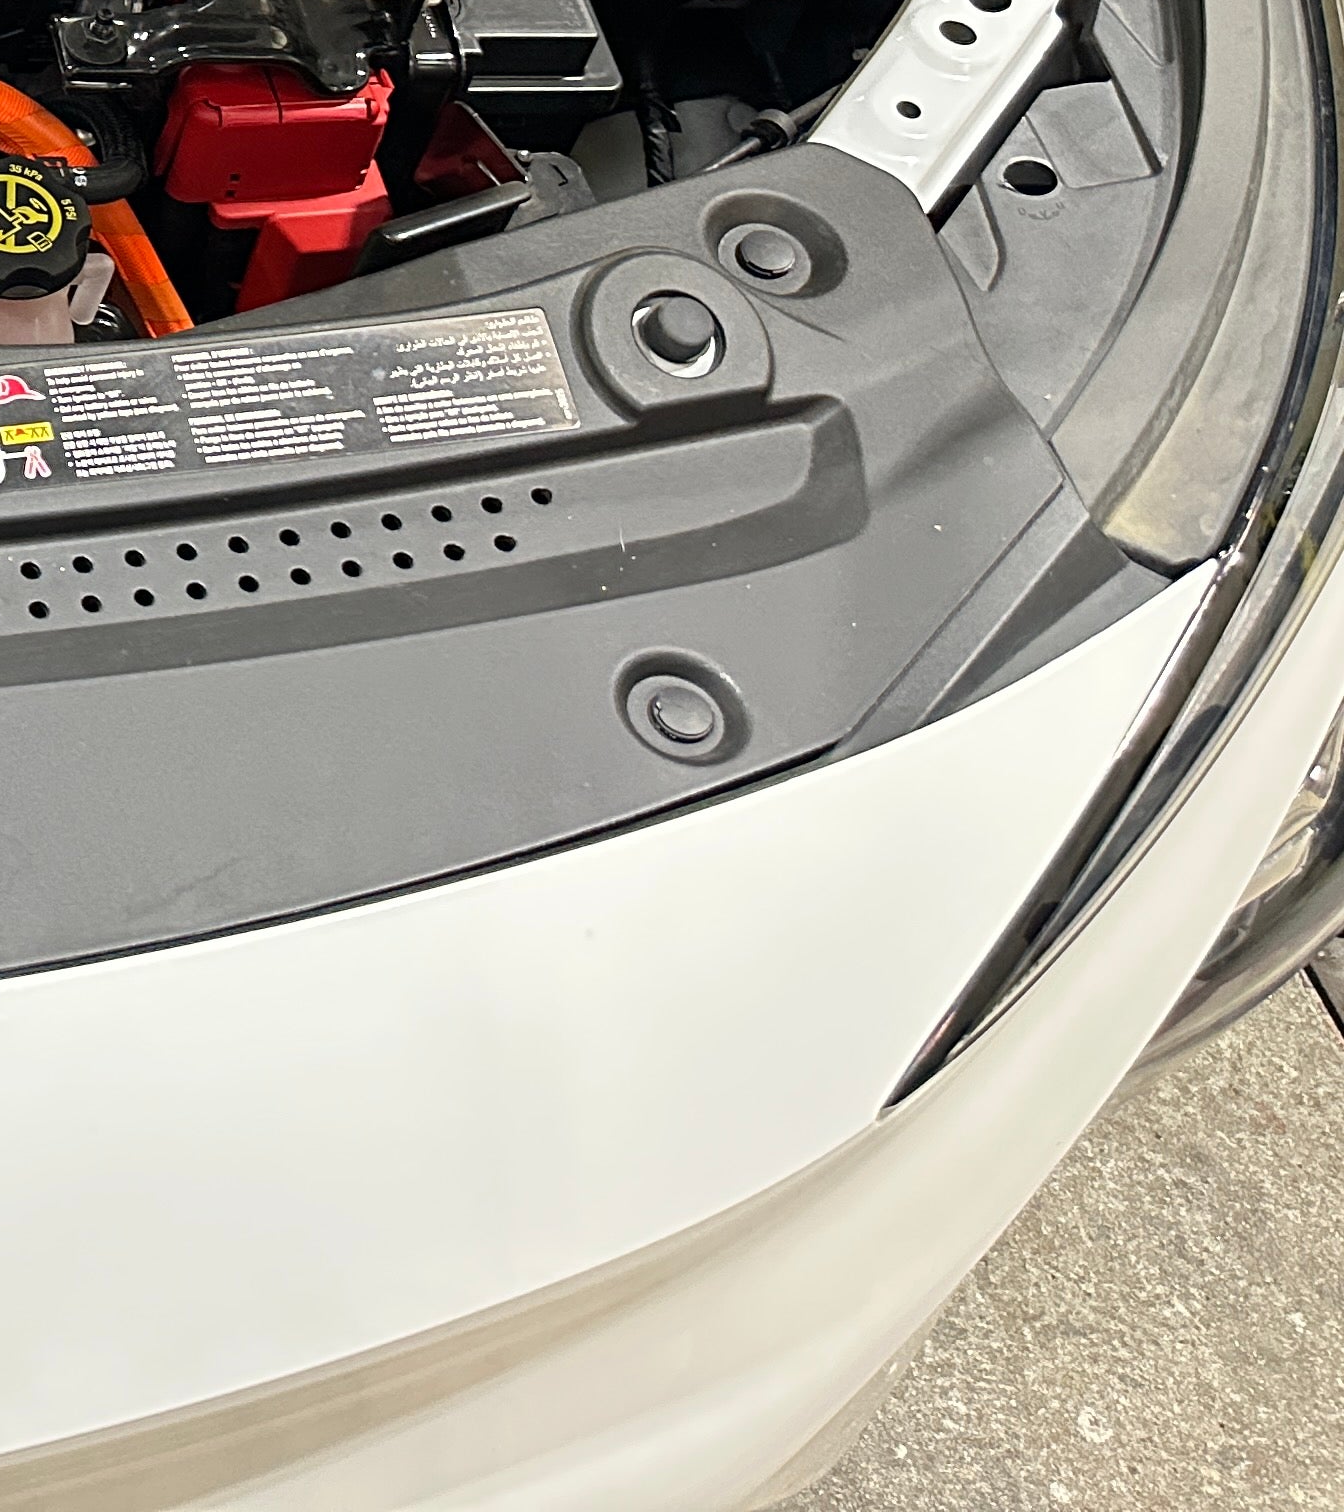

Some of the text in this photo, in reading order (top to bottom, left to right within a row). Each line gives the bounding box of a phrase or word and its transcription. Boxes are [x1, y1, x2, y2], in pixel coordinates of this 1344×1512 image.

[9, 163, 44, 181] 35 kPa
[63, 205, 78, 222] PSI
